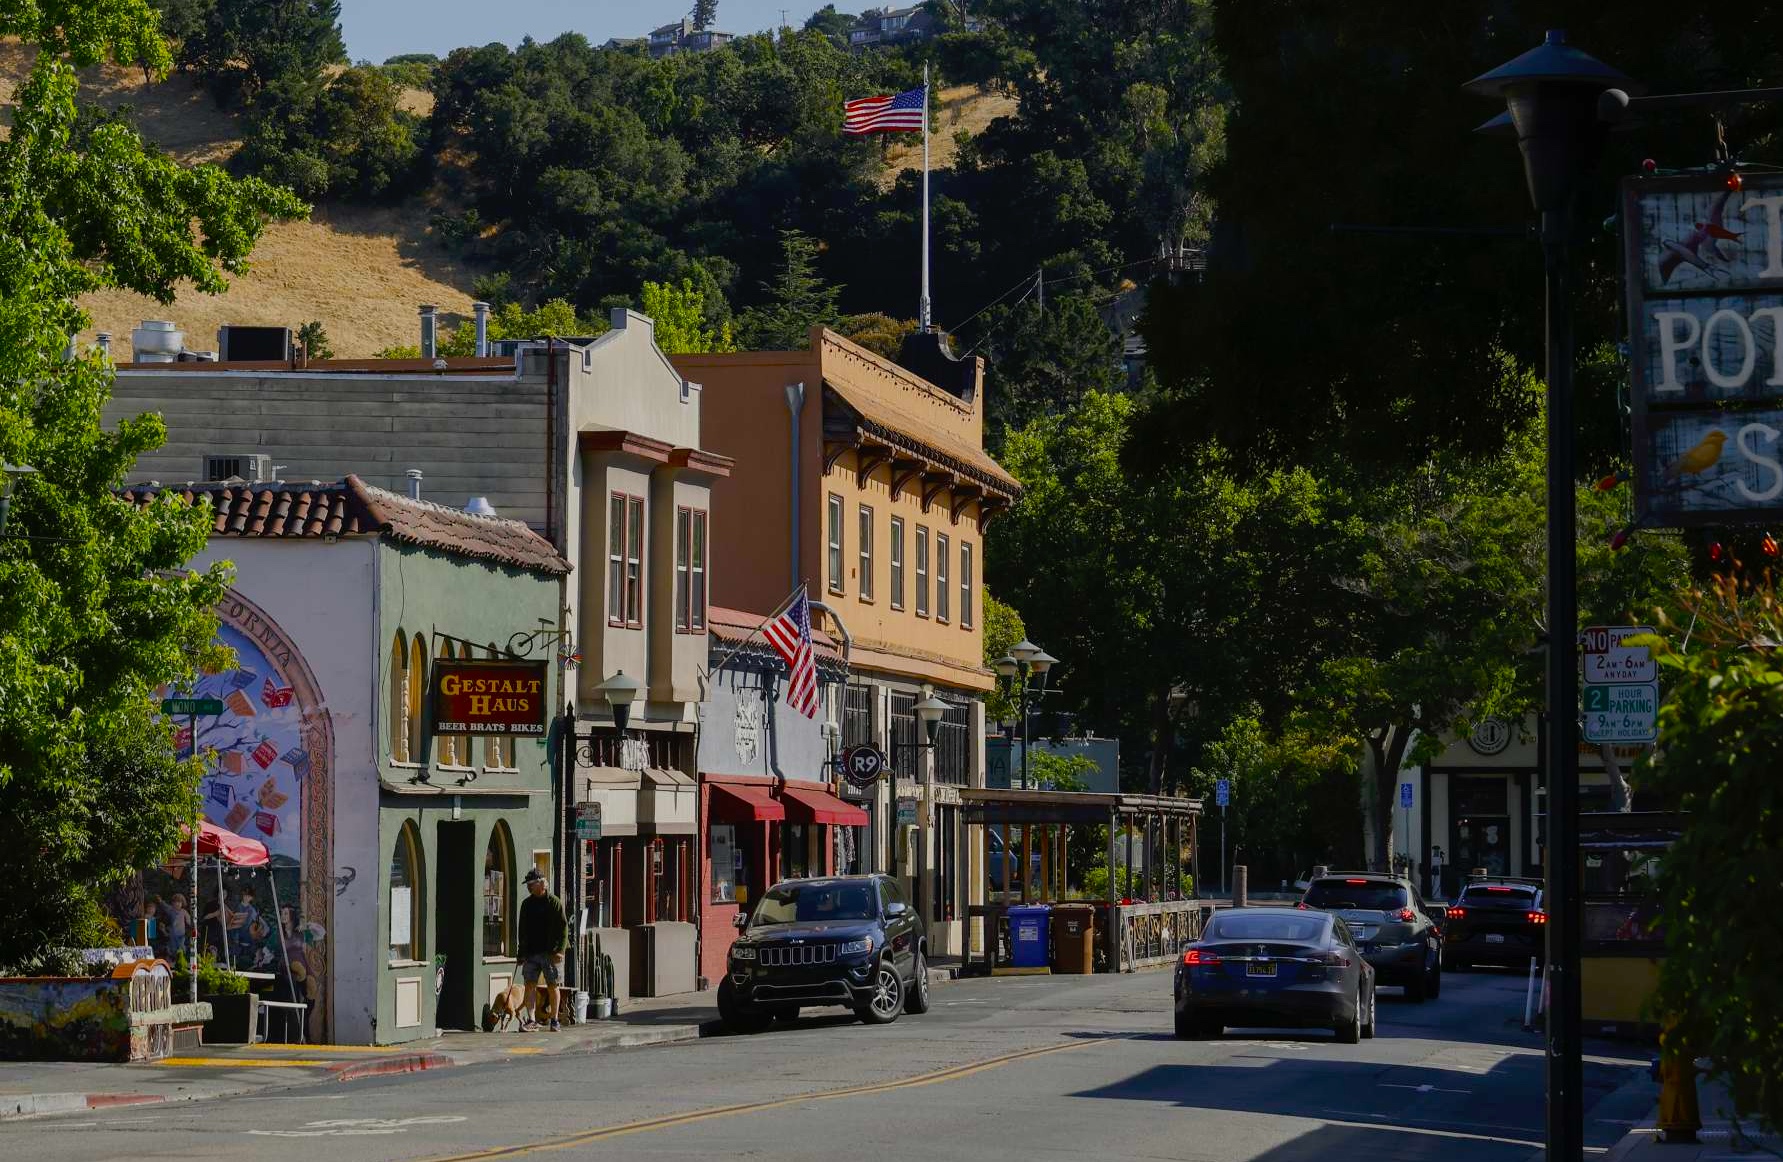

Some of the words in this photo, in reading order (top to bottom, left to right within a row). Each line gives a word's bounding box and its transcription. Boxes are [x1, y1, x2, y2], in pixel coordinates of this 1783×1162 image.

[1585, 631, 1607, 651] NO
[440, 674, 541, 696] GESTALT
[468, 694, 530, 716] HAUS
[1590, 690, 1601, 709] 2
[1618, 688, 1642, 699] HOUR
[1608, 699, 1652, 713] PARKING
[438, 722, 467, 731] BEER
[469, 723, 506, 732] BRATS
[510, 723, 544, 733] BIKES
[852, 755, 877, 772] R9
